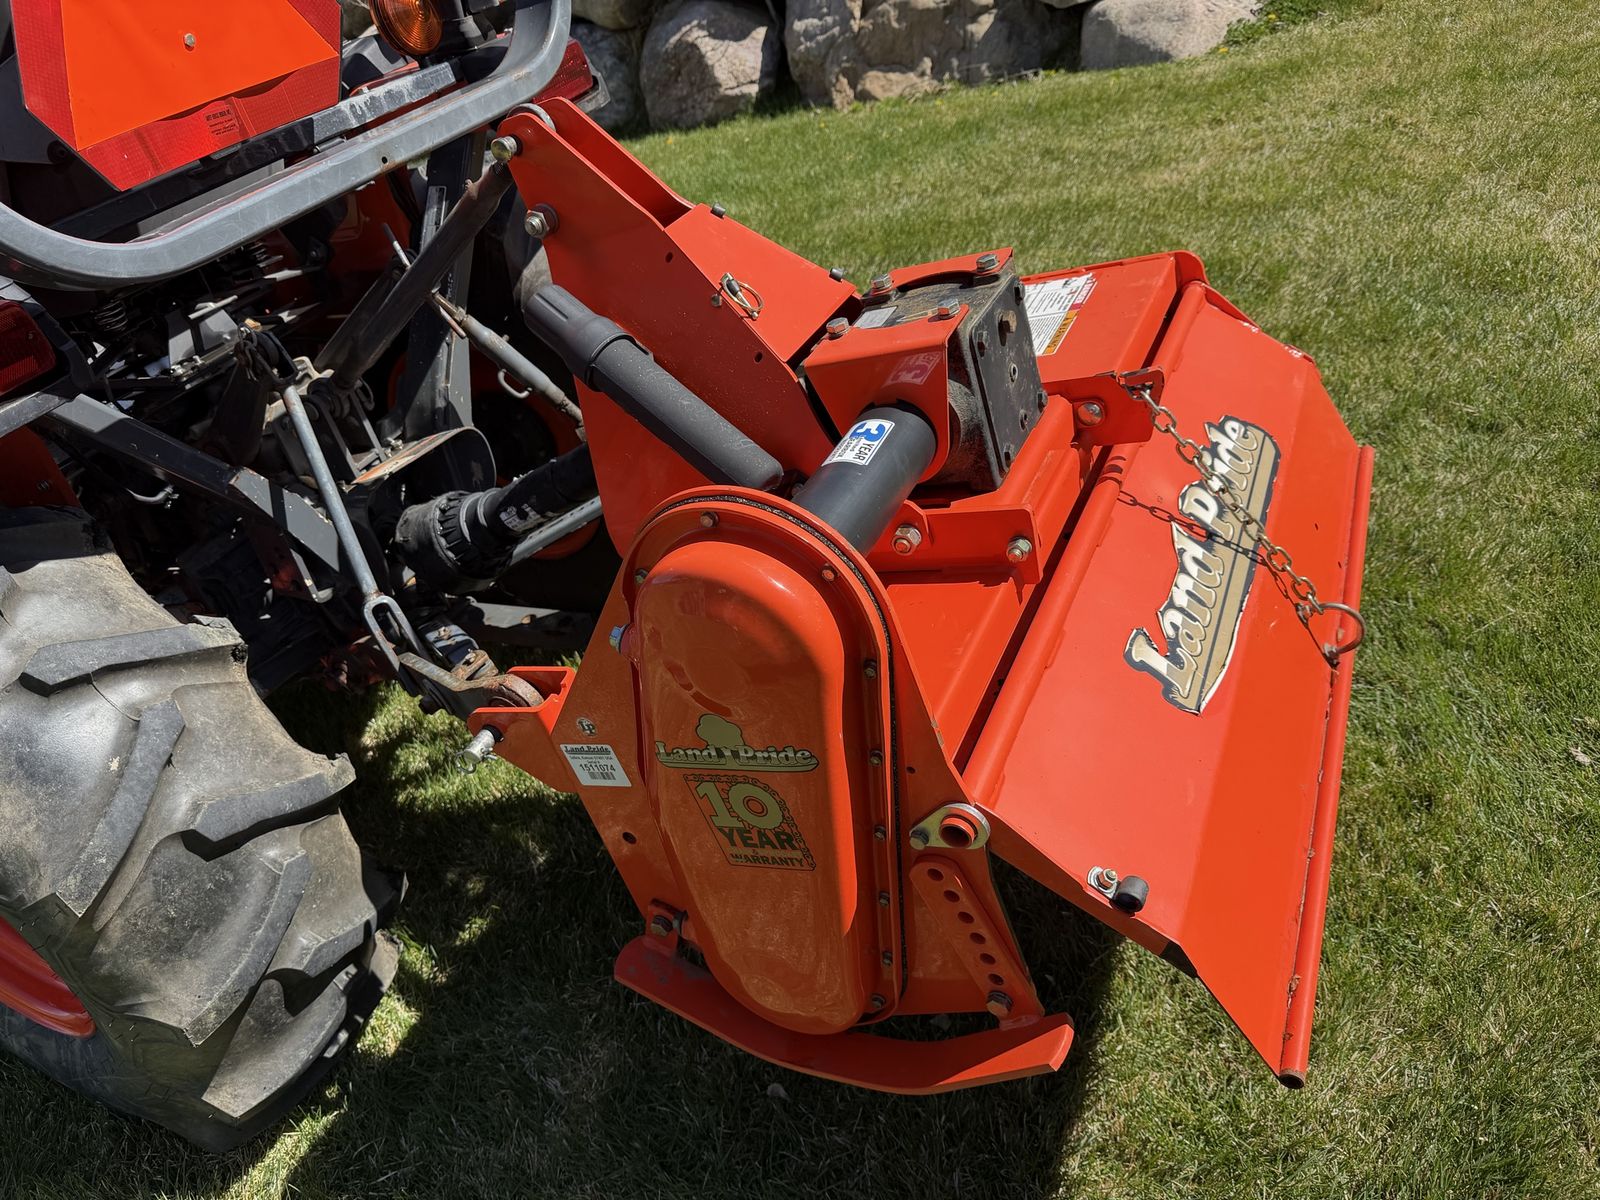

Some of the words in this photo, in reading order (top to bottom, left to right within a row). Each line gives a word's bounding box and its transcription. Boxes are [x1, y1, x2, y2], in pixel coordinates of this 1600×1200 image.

[849, 422, 886, 442] 3
[853, 443, 875, 461] YEAR
[1131, 524, 1225, 699] Land
[564, 745, 585, 753] Land
[655, 741, 722, 763] Land
[735, 745, 814, 765] Pride
[579, 764, 616, 772] 1511074
[695, 781, 786, 830] 10
[716, 827, 801, 851] YEAR
[729, 853, 805, 867] WARRANTY
